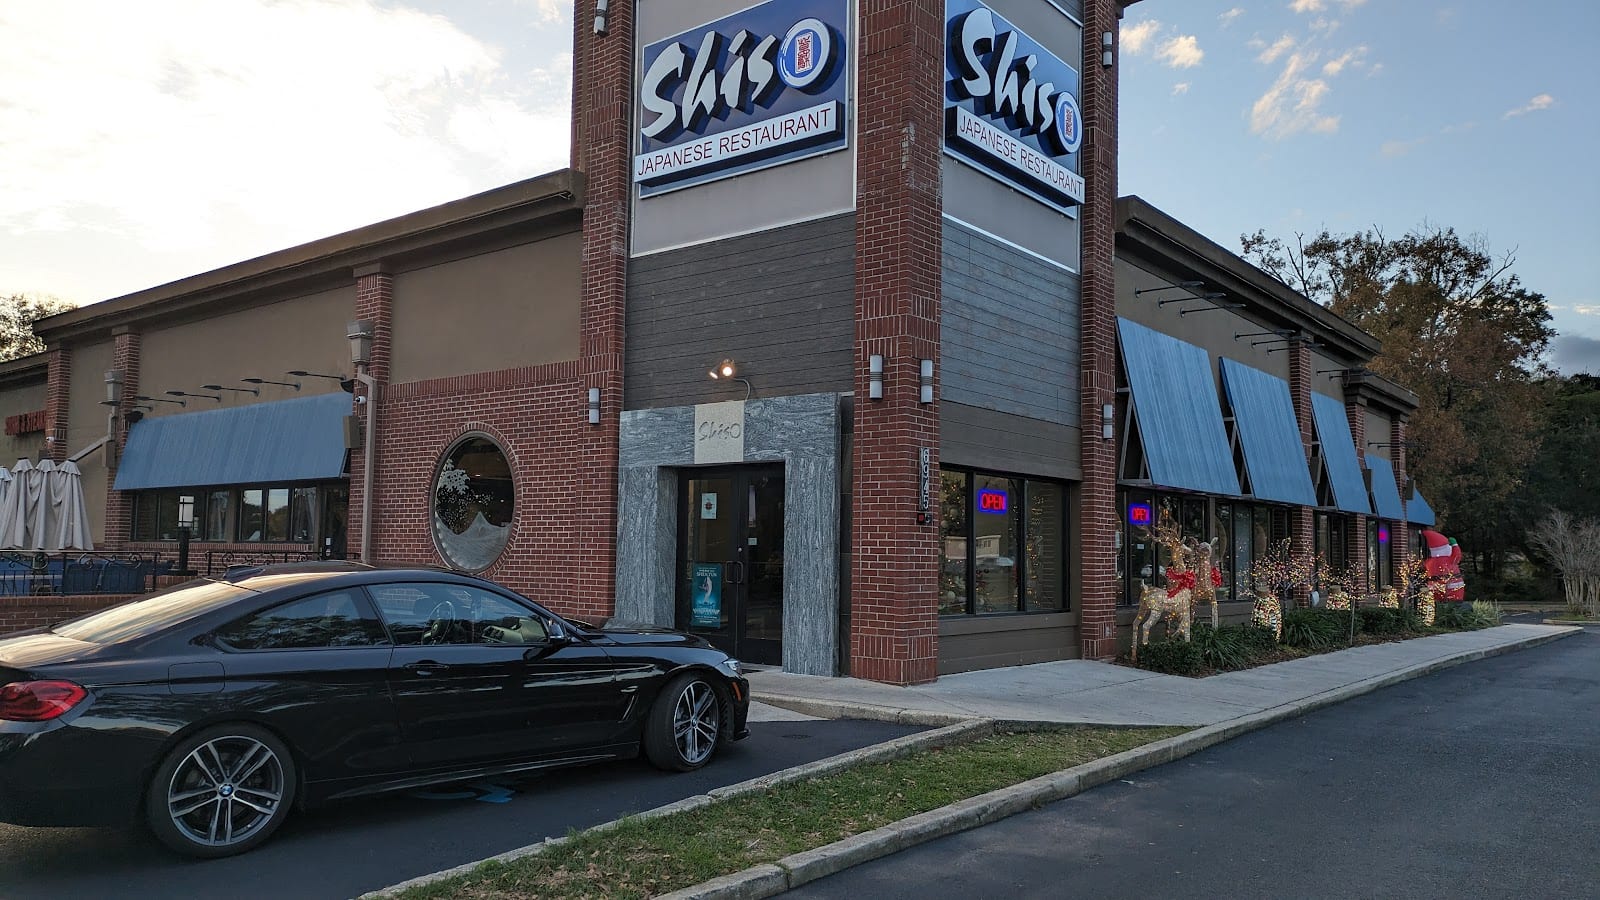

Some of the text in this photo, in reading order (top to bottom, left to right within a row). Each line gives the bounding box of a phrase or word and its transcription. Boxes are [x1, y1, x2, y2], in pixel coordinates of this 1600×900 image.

[637, 107, 832, 176] JAPANESE RESTAURANT
[959, 114, 1017, 160] JAPANESE
[1020, 139, 1083, 197] RESTAURANT
[981, 493, 1005, 510] OPEN
